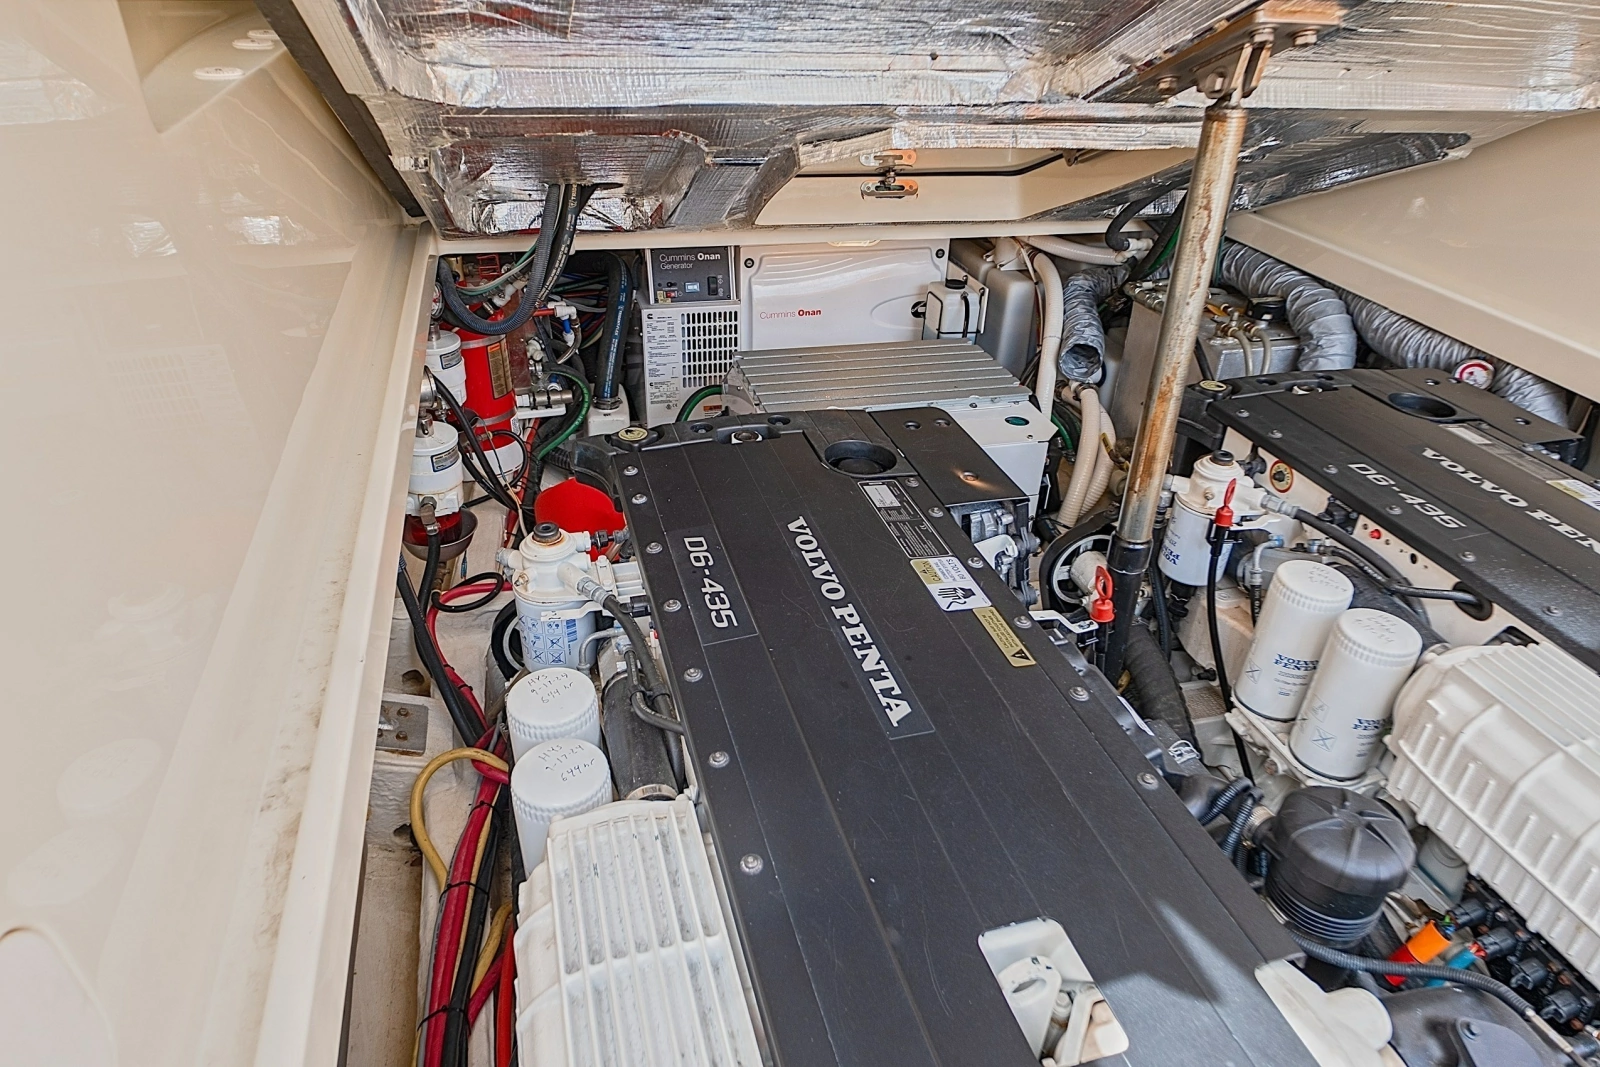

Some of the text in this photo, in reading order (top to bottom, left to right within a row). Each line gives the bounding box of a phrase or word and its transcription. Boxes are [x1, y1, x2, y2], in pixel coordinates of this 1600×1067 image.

[660, 254, 695, 262] Cummins
[1347, 463, 1467, 528] D6-435
[1422, 447, 1529, 508] VOLVO
[683, 536, 738, 628] D6-435
[921, 561, 941, 581] CAUTION
[946, 559, 961, 575] VOLTS
[786, 516, 846, 600] VOLVO
[830, 603, 912, 728] PENTA
